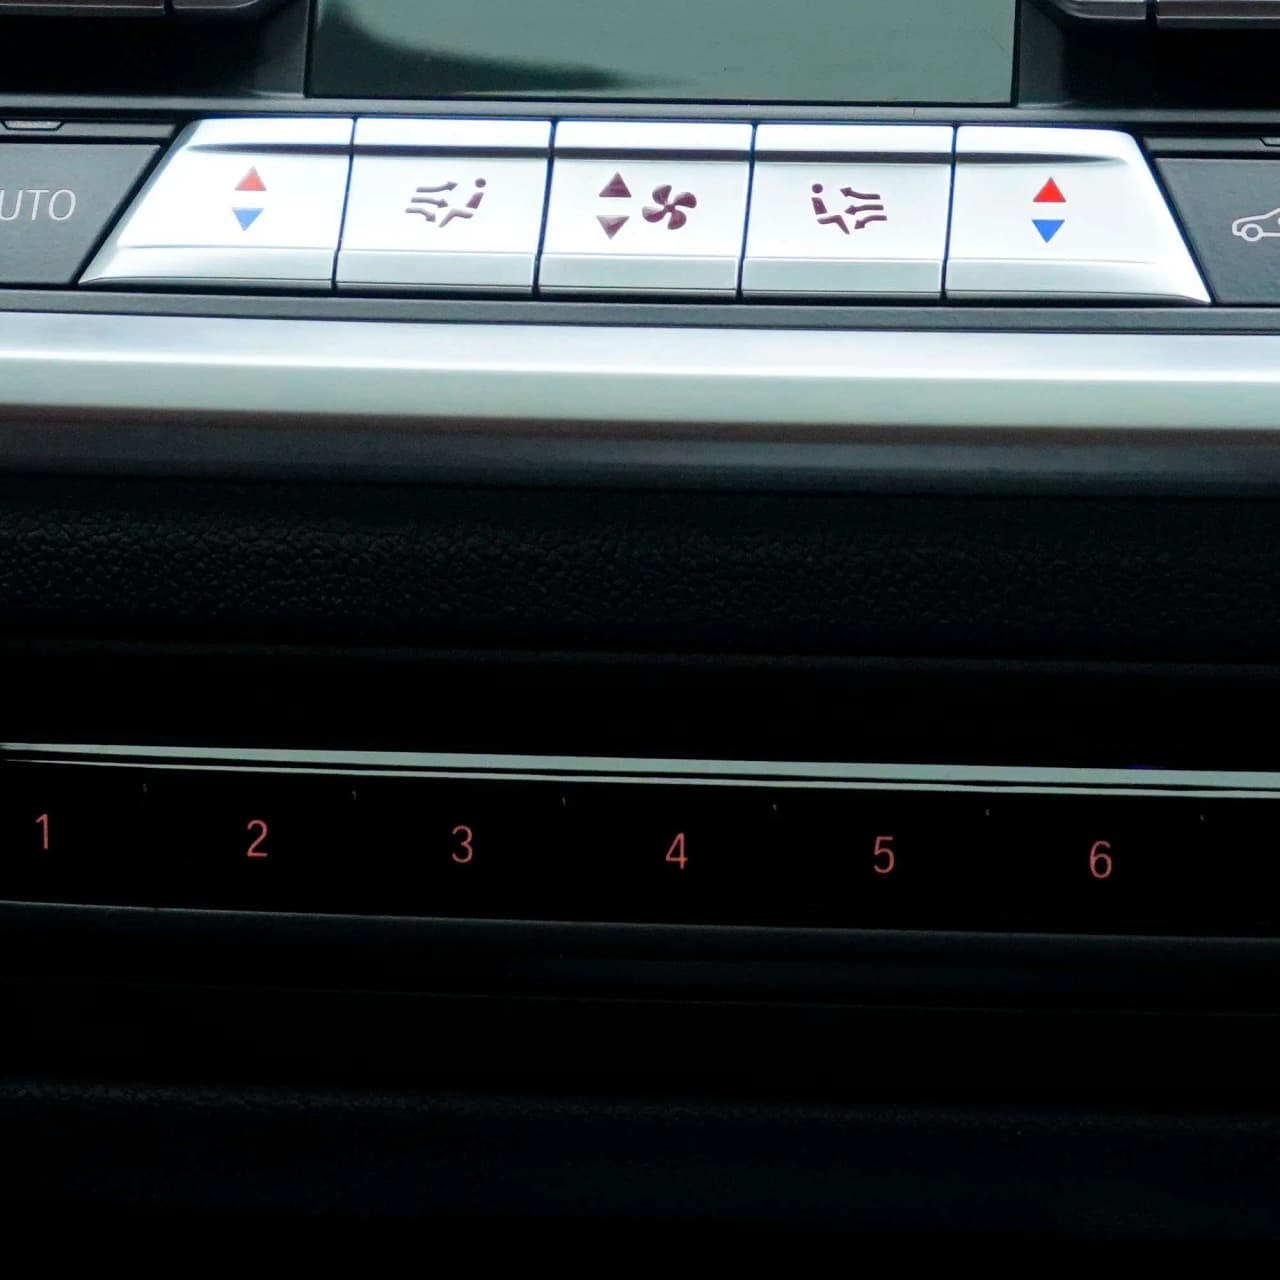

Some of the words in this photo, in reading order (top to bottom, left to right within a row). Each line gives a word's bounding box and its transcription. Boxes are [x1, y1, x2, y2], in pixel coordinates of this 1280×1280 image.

[34, 813, 49, 850] 1
[246, 819, 268, 858] 2
[451, 824, 474, 864] 3
[665, 832, 688, 870] 4
[873, 835, 895, 874] 5
[1089, 840, 1113, 879] 6
